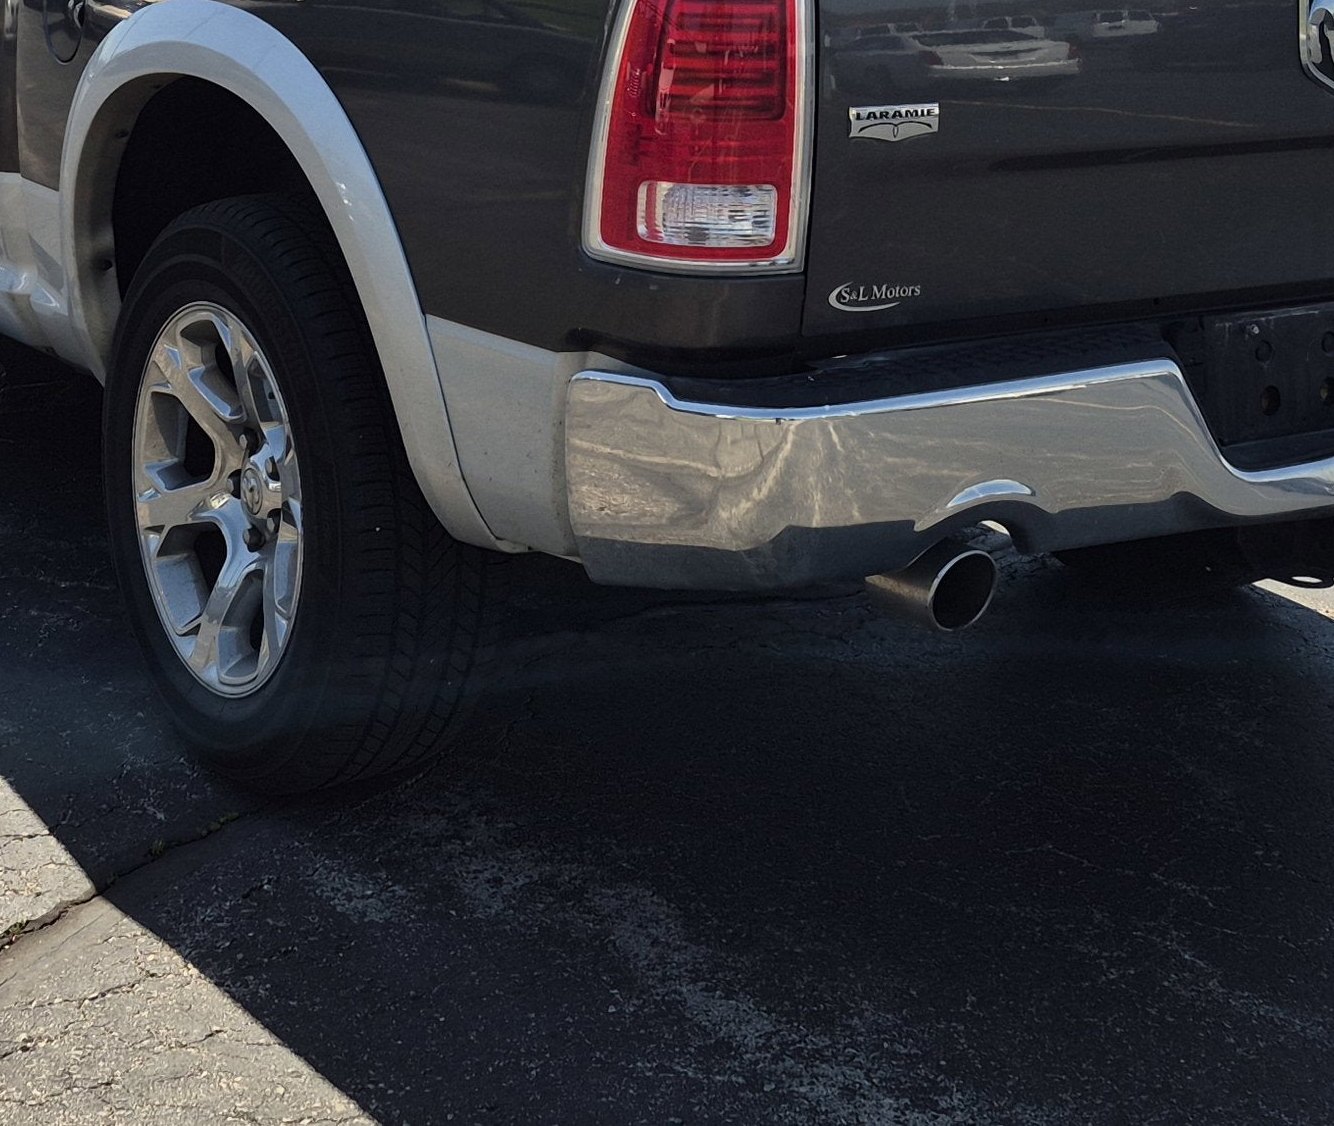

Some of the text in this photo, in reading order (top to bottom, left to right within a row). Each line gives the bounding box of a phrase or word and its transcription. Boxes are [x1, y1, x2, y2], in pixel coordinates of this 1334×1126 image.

[856, 108, 936, 121] LARAMIE
[840, 283, 921, 303] S&L Motors
